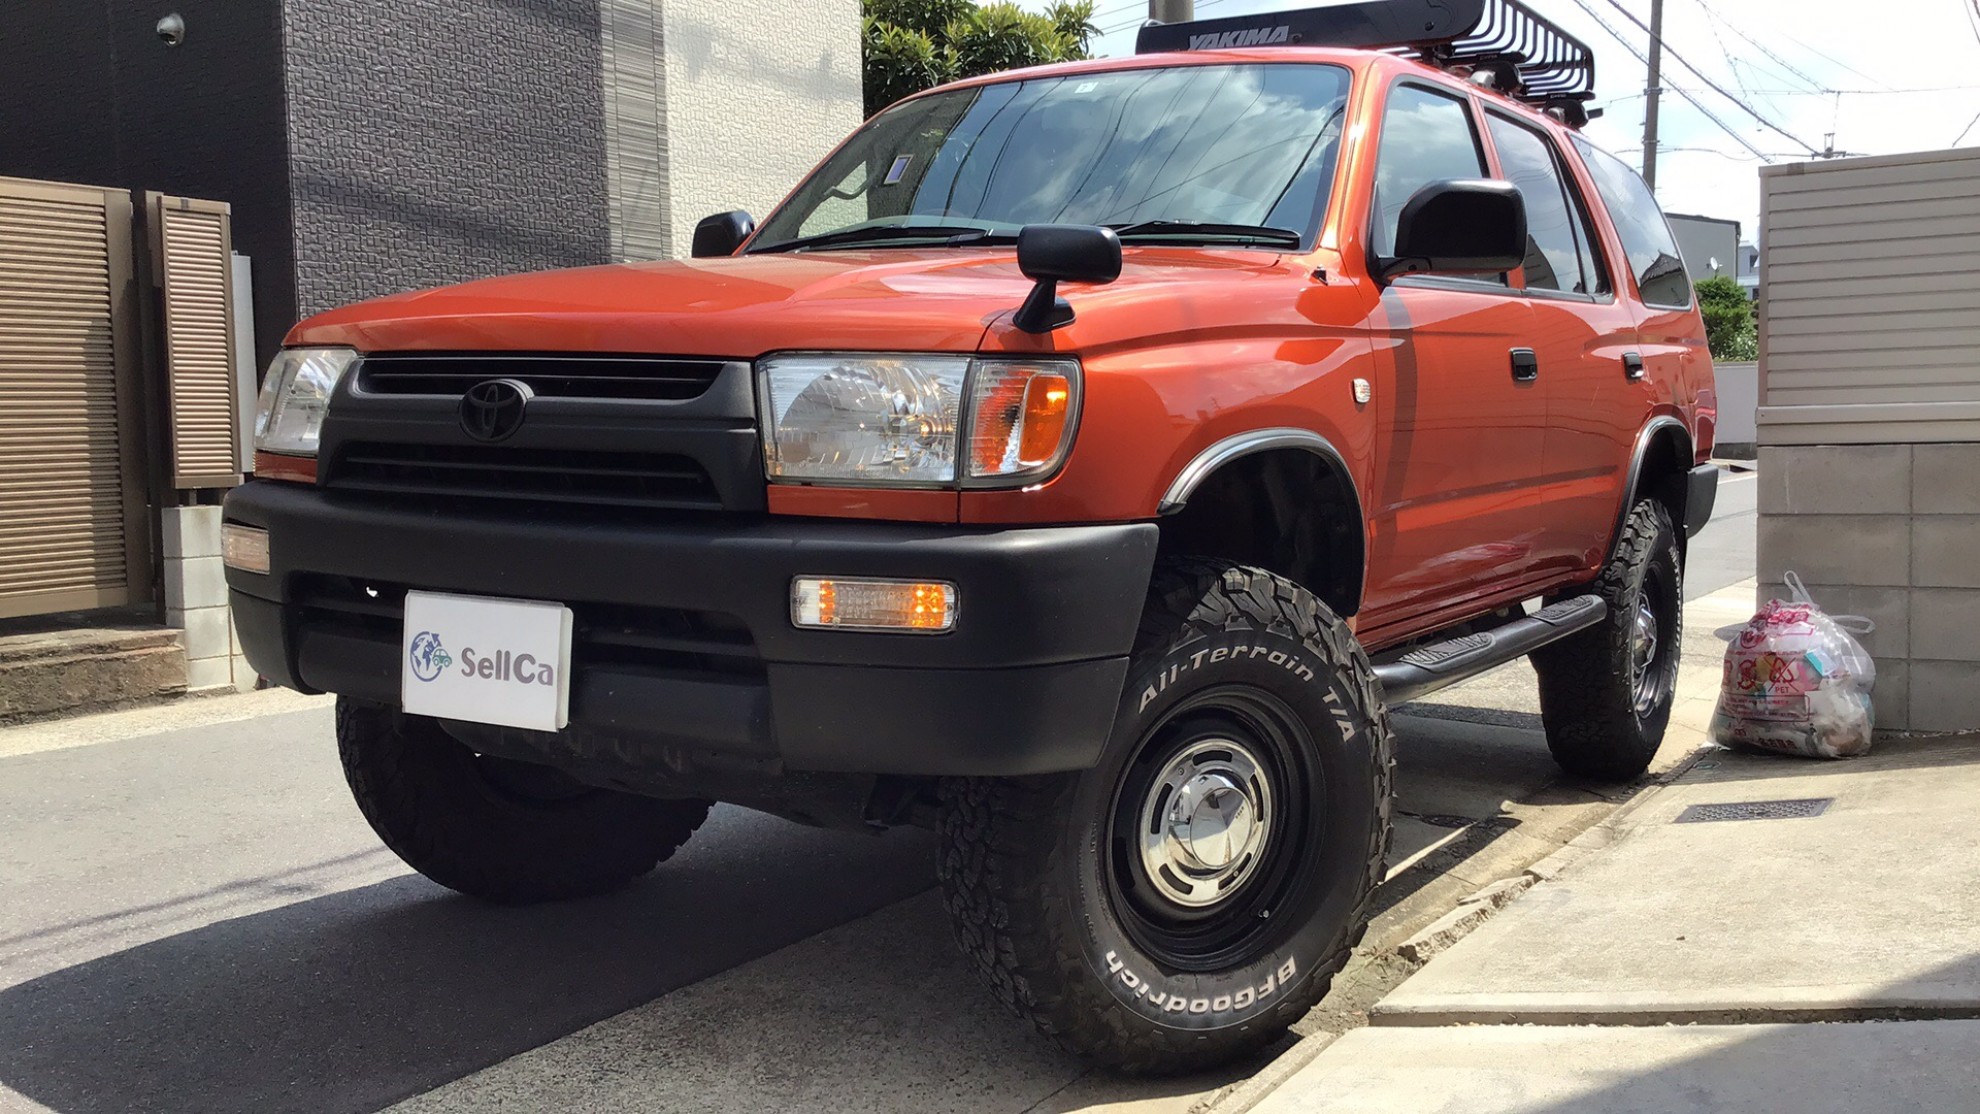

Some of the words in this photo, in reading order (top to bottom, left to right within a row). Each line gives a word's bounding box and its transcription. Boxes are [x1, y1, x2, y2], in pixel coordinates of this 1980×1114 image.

[1188, 25, 1290, 51] YAKIMA
[461, 647, 554, 687] SellCa
[1138, 644, 1315, 714] All-Terrain
[1321, 685, 1355, 743] T/A
[1775, 686, 1789, 694] PET
[1104, 949, 1297, 1015] BFGoodrich
